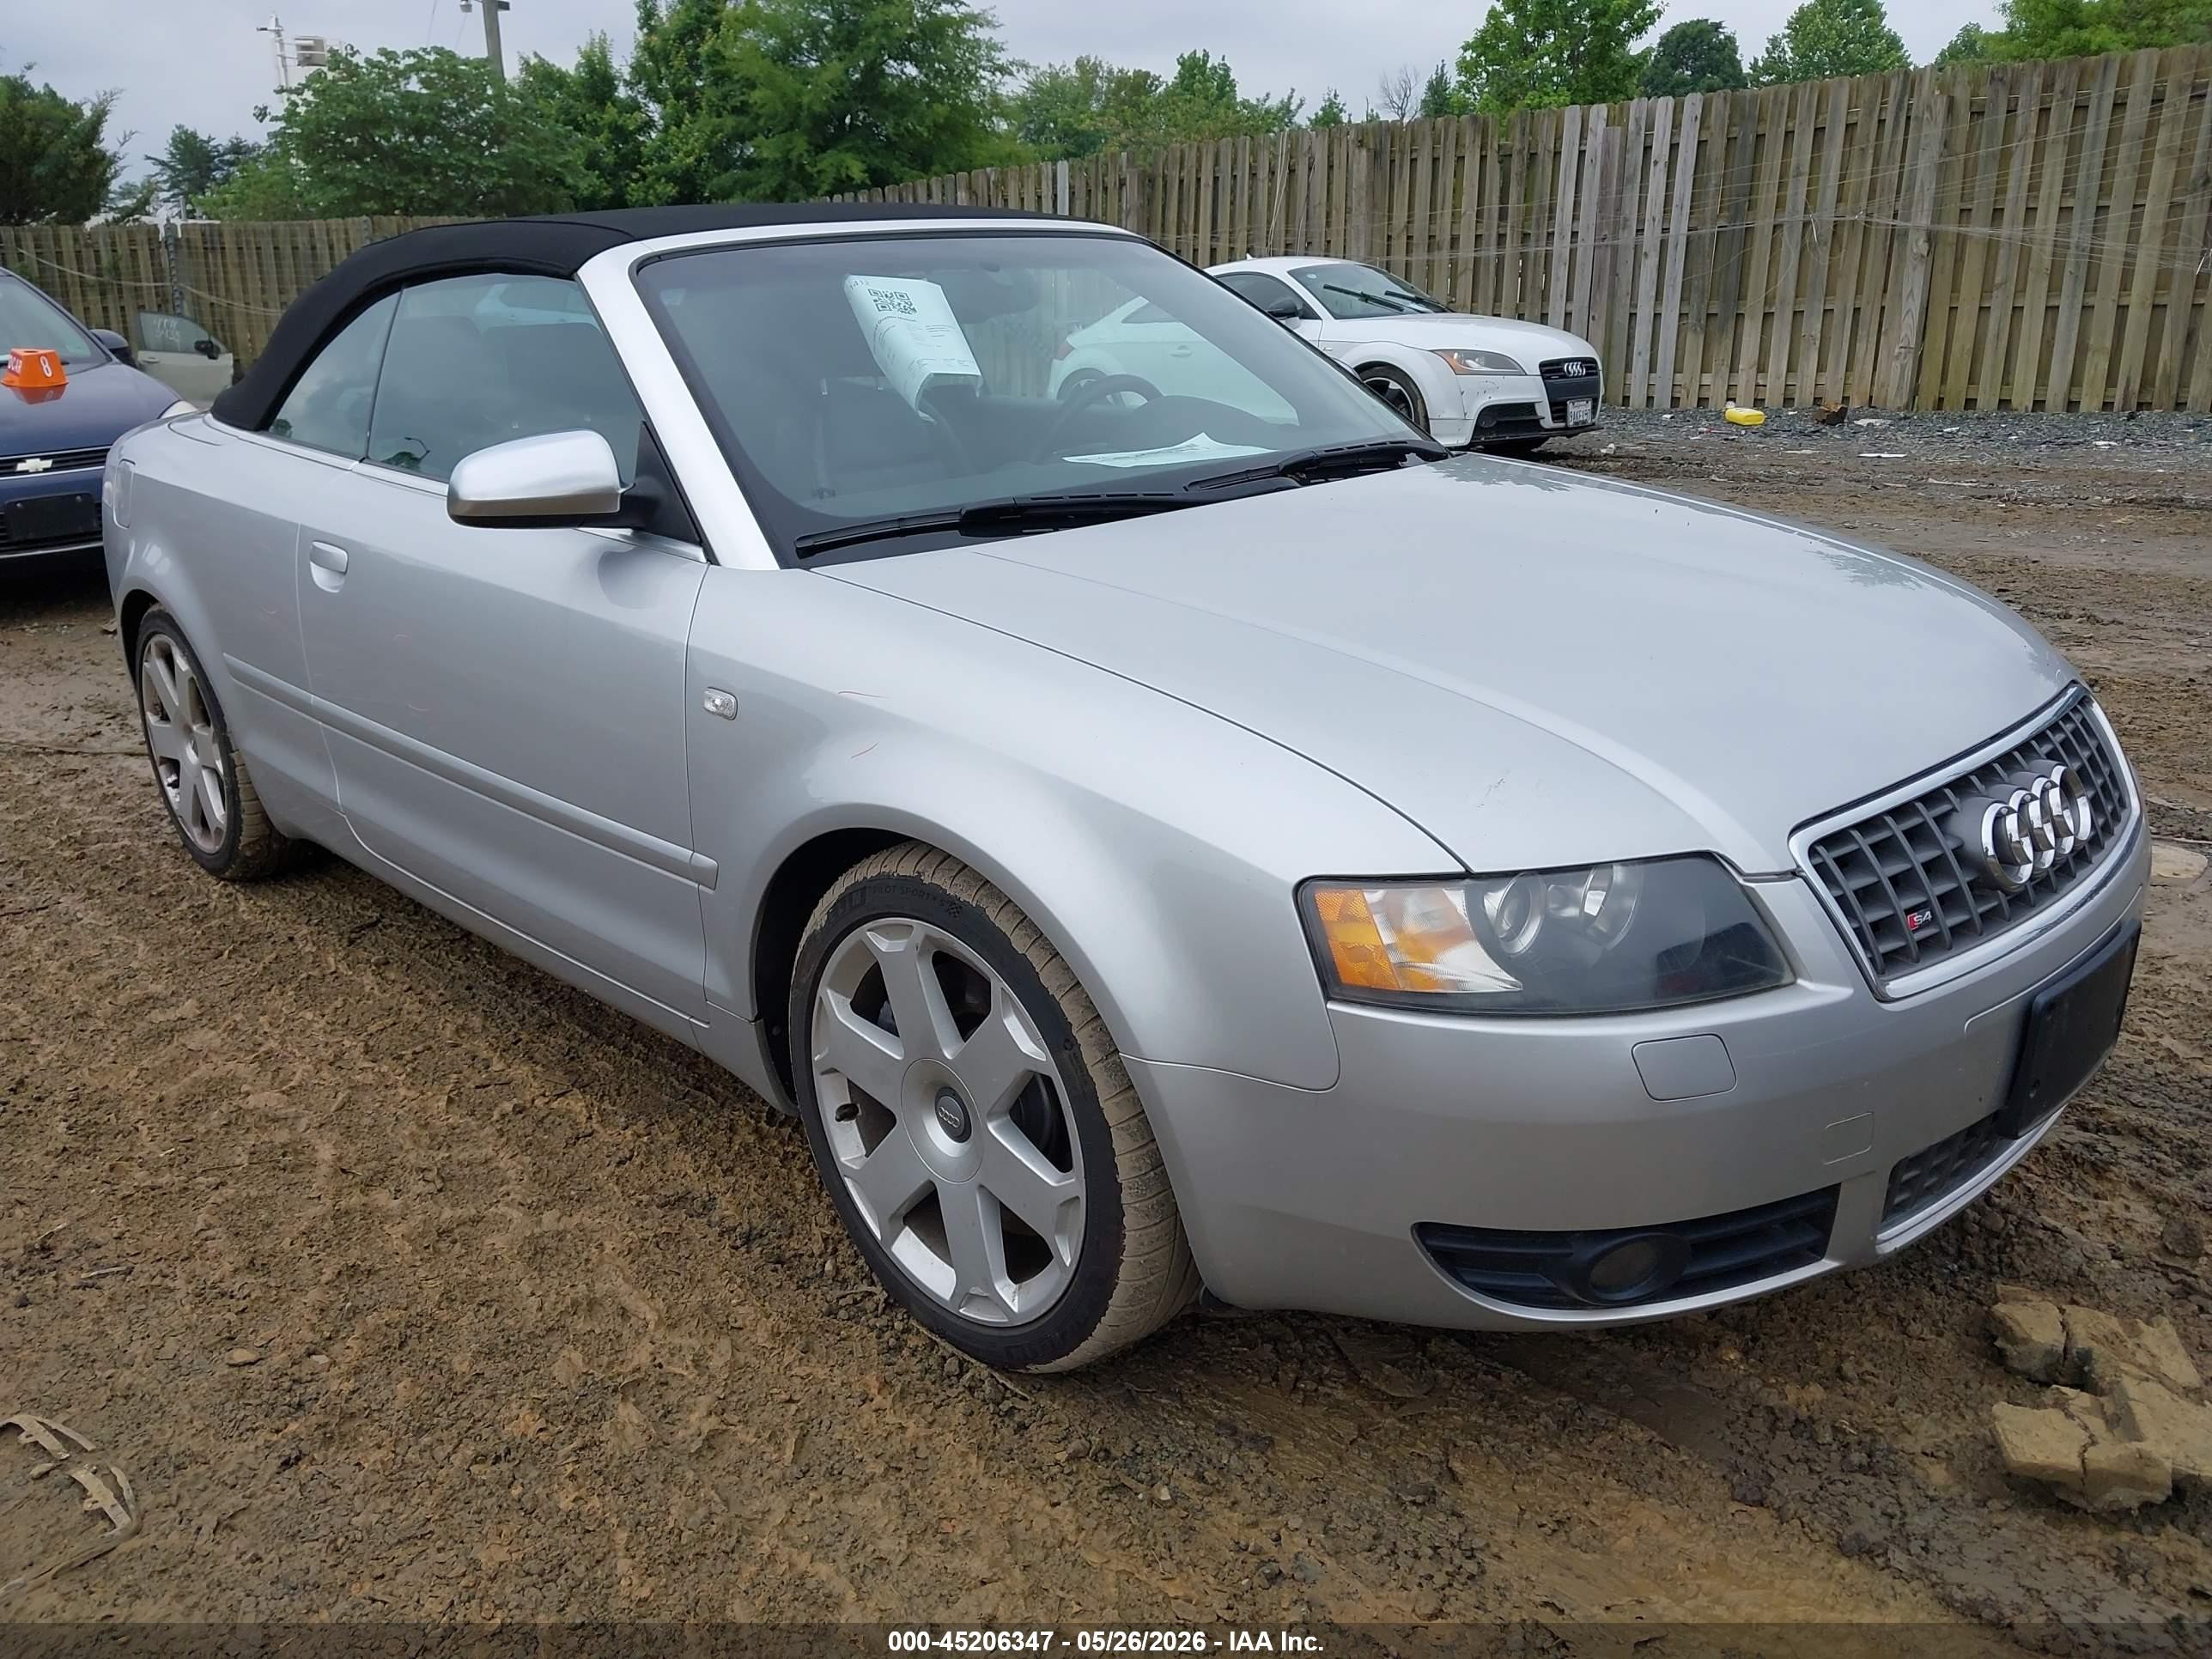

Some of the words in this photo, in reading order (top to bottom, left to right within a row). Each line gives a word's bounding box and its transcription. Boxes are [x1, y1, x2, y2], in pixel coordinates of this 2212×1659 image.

[40, 356, 52, 378] 8
[872, 885, 896, 894] PILOT
[900, 886, 930, 900] SPORT
[1913, 910, 1932, 925] S4
